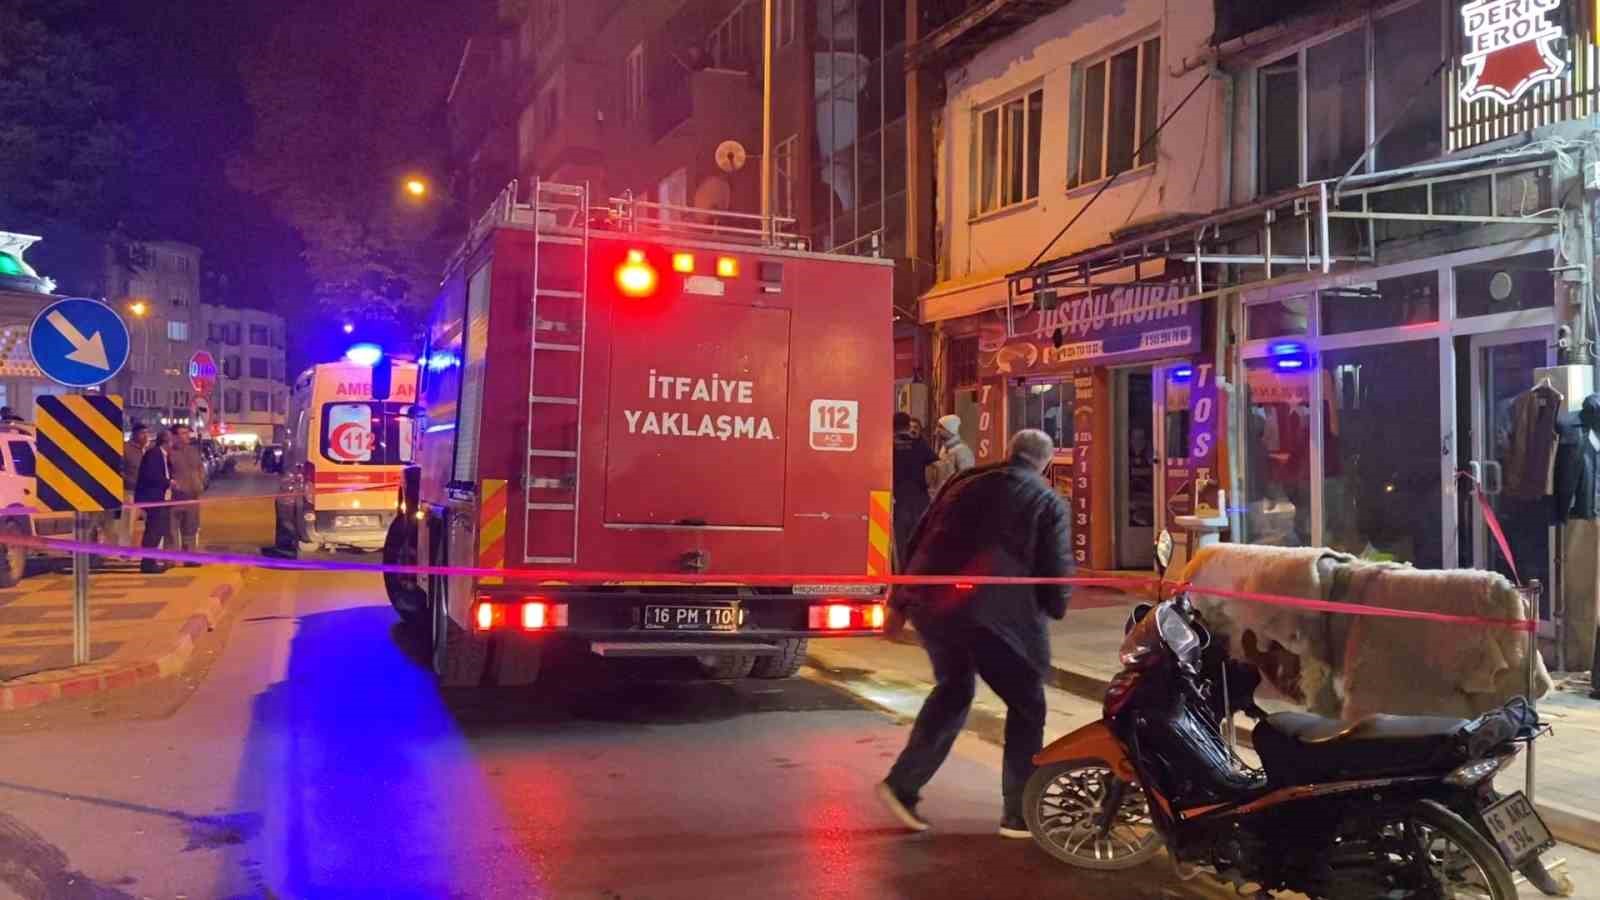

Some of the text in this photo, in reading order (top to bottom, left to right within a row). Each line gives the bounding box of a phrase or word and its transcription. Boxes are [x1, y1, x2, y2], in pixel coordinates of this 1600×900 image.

[1469, 0, 1554, 32] DERI
[1478, 15, 1547, 52] EROL
[648, 369, 753, 404] İTFAİYE
[624, 410, 774, 441] YAKLAŞMA
[817, 405, 851, 429] 112
[343, 431, 377, 451] 112
[654, 608, 731, 624] 16 PM 110
[1487, 813, 1506, 833] 16
[1508, 827, 1534, 851] 394
